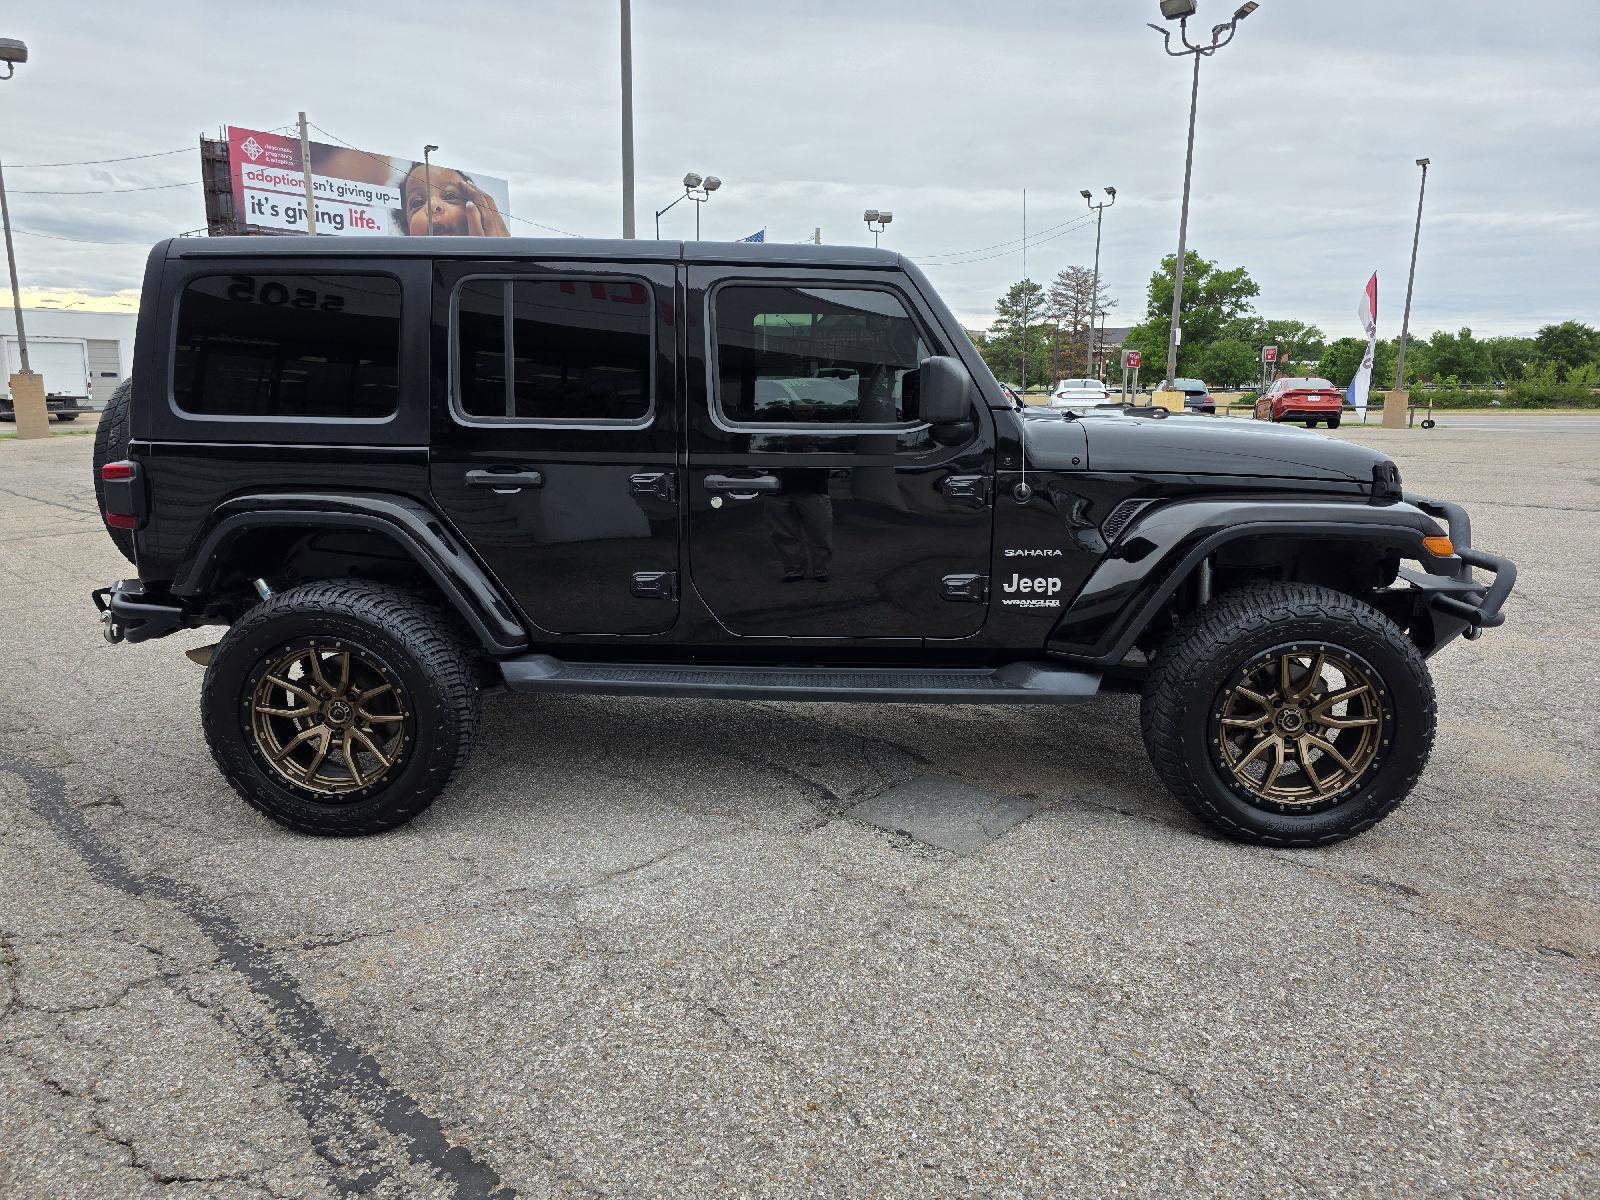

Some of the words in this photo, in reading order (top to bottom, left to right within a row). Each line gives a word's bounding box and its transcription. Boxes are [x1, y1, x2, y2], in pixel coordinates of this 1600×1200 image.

[247, 170, 305, 187] adoption
[312, 180, 334, 193] sn't
[337, 184, 373, 201] giving
[250, 195, 280, 217] it's
[349, 208, 381, 231] life.
[1004, 549, 1063, 557] SAHARA
[1003, 573, 1062, 596] Jeep
